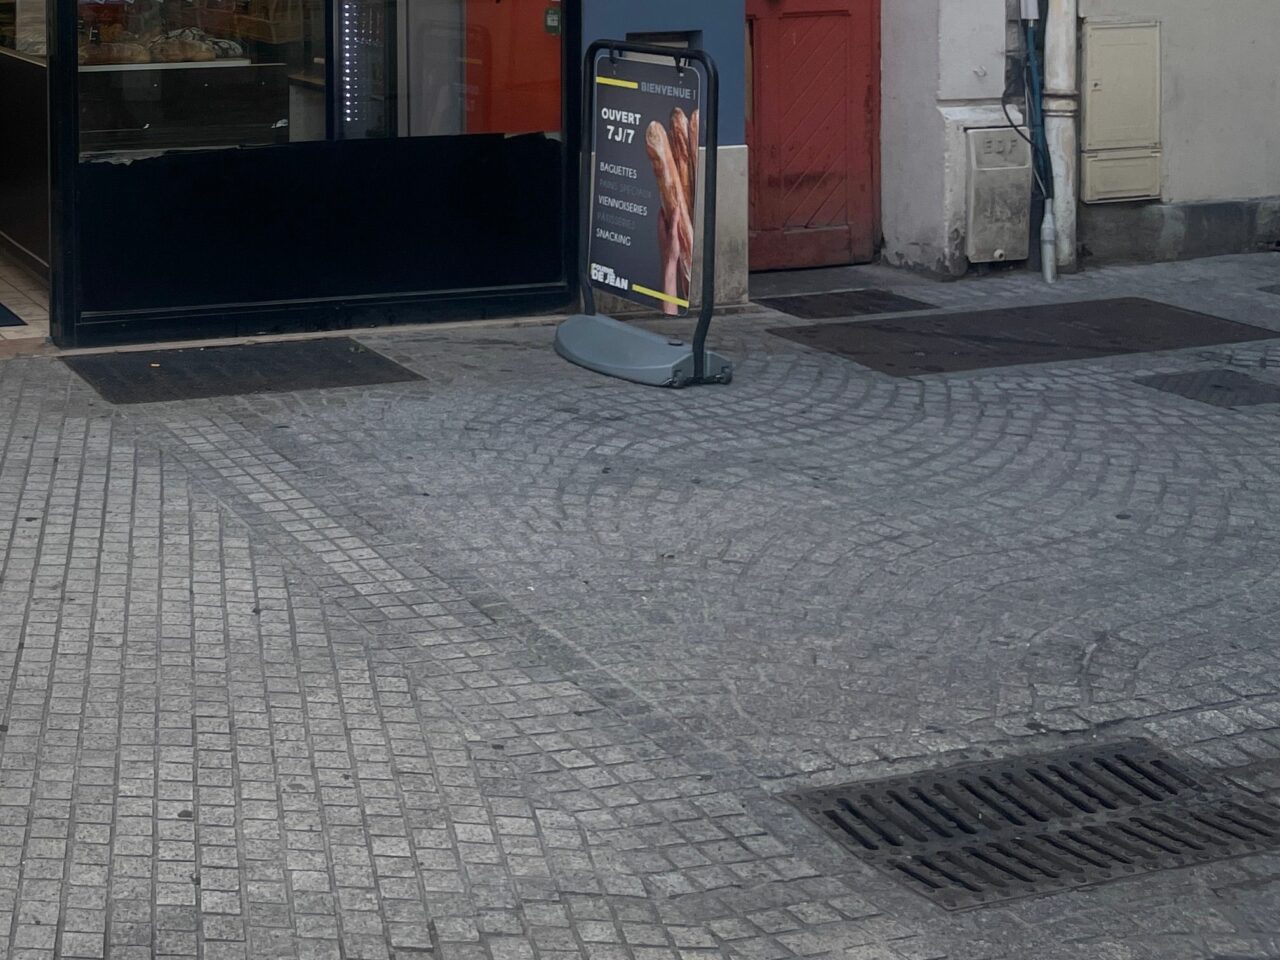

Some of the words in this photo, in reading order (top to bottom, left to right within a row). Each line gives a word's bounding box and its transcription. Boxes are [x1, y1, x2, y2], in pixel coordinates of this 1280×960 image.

[640, 81, 691, 100] BIENVENUE
[601, 107, 641, 125] OUVERT
[599, 161, 637, 179] BAGUETTES
[598, 194, 648, 216] VIENNOISERIES
[596, 228, 631, 246] SNACKING
[604, 272, 629, 290] JEAN
